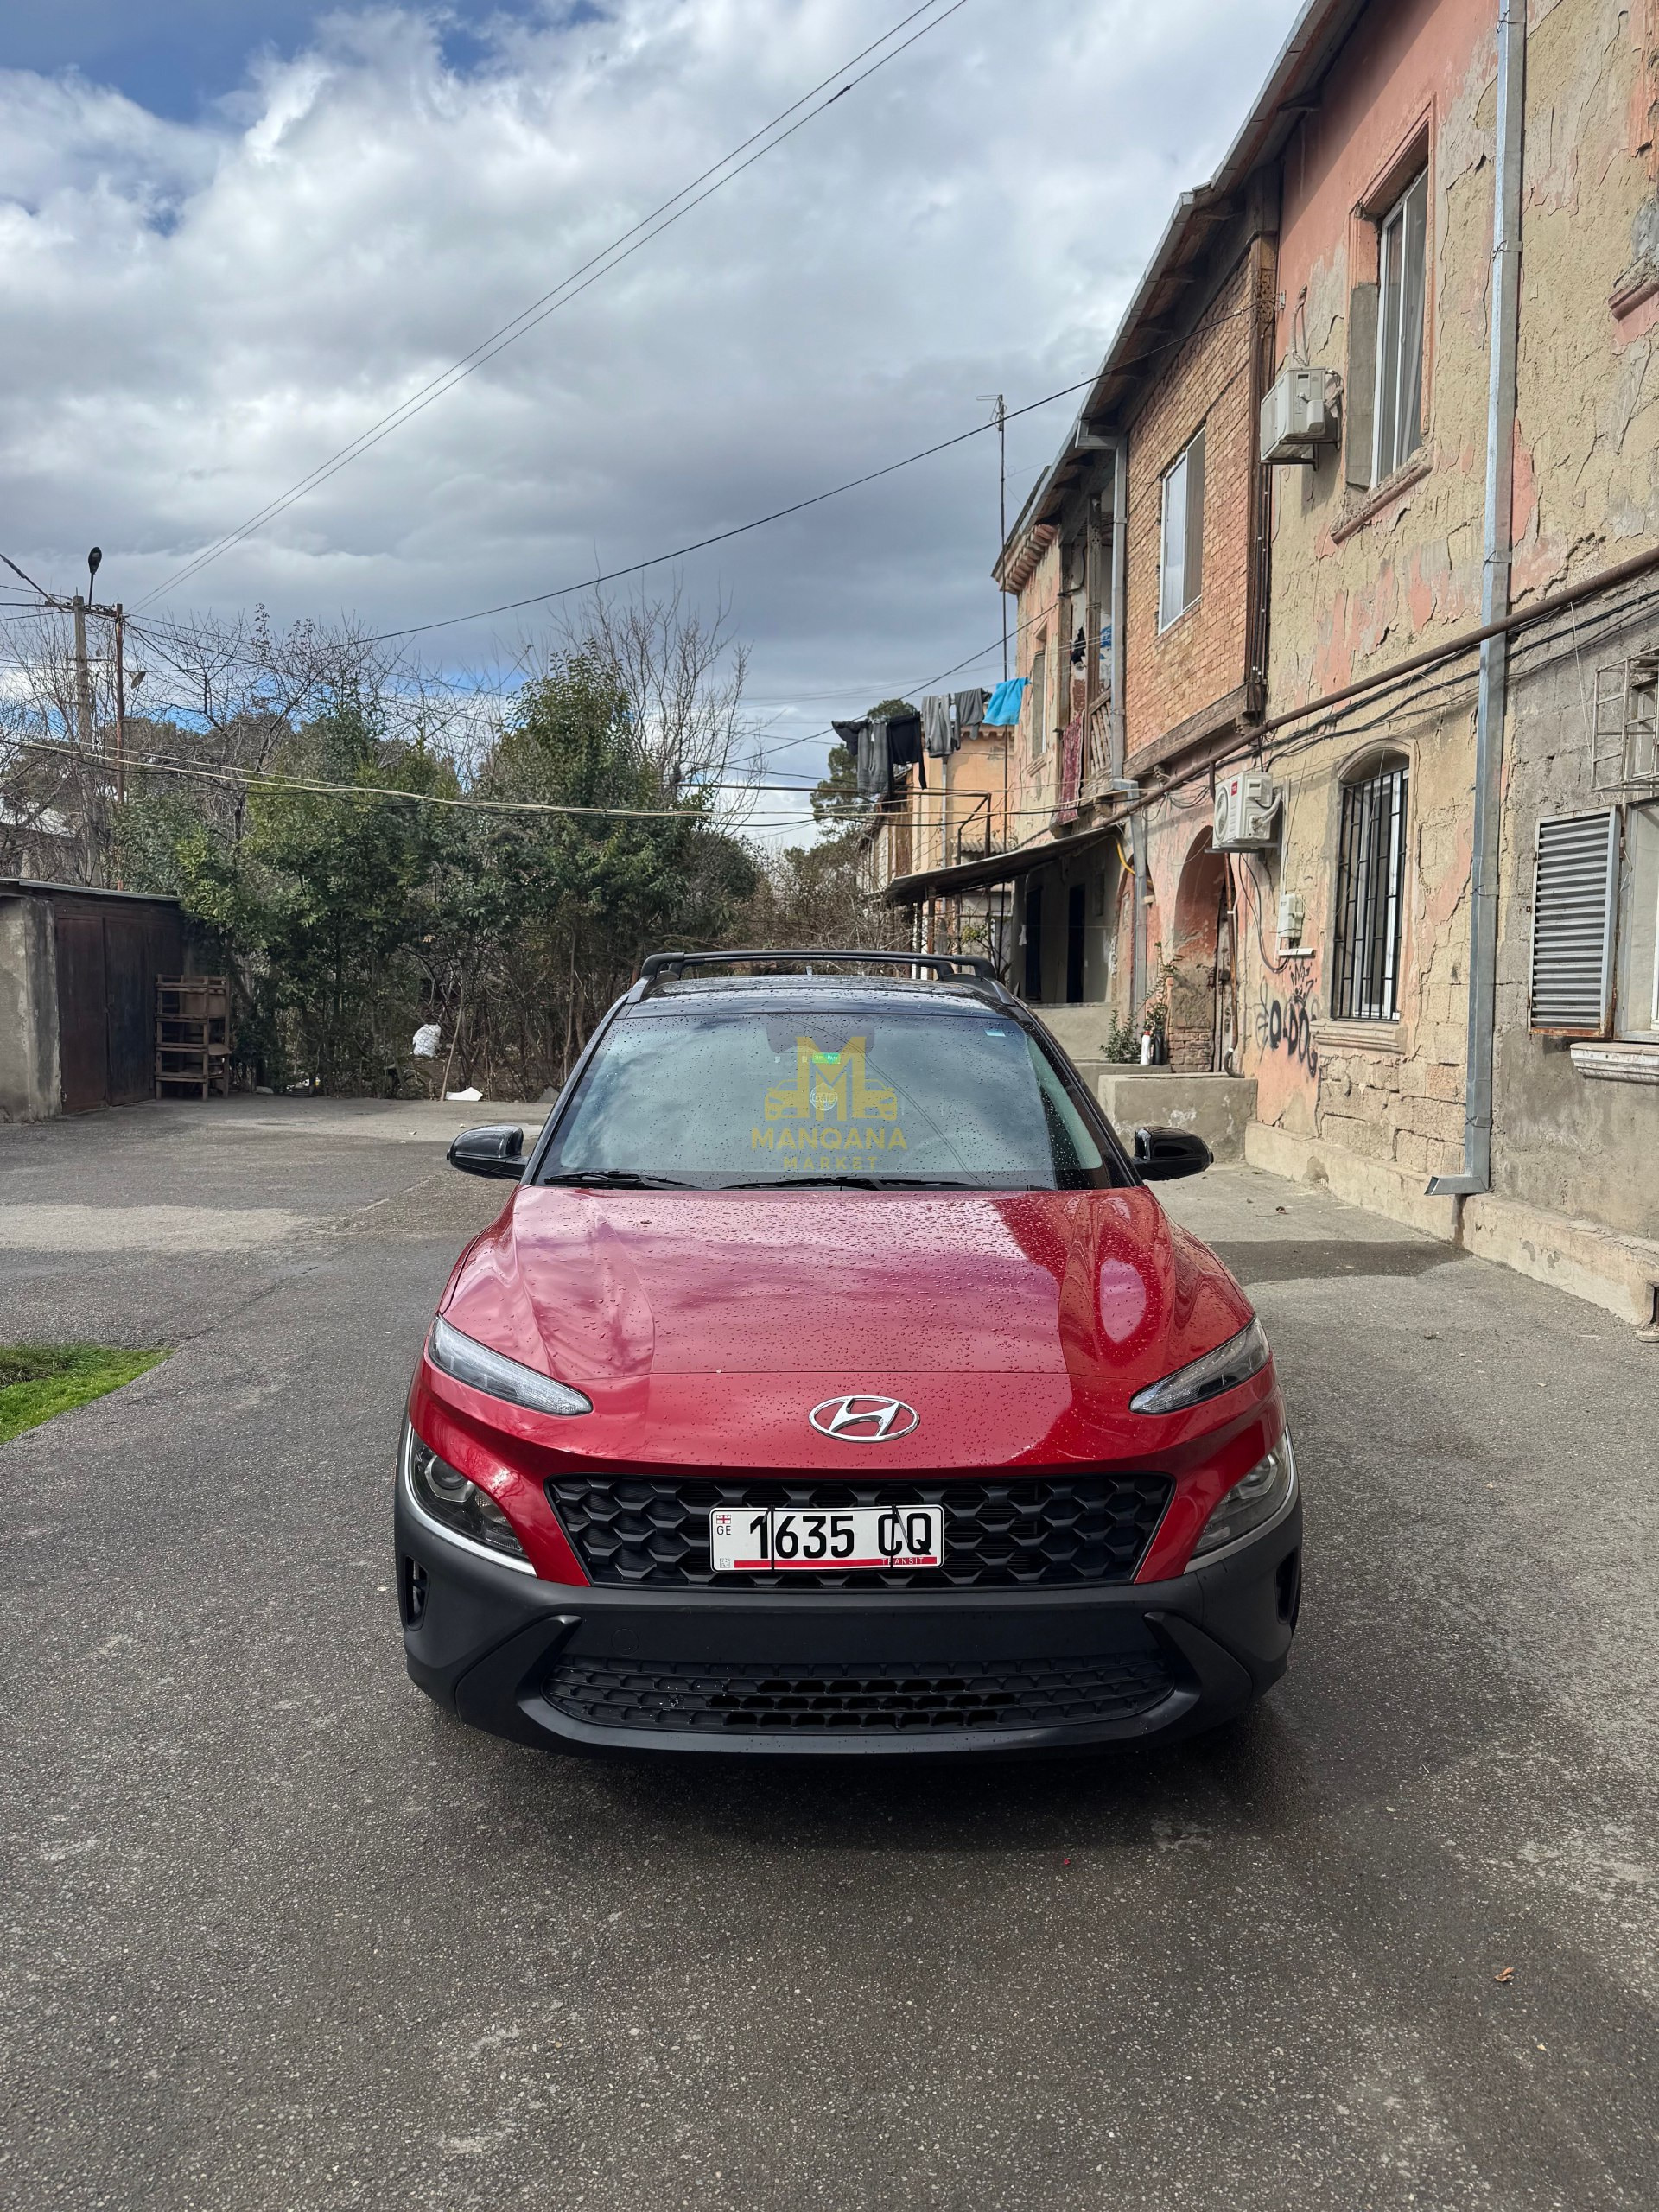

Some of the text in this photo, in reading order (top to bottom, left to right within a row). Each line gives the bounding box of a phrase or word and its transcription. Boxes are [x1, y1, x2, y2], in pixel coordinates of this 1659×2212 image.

[716, 1525, 732, 1535] GE
[750, 1512, 932, 1560] 1635 CQ
